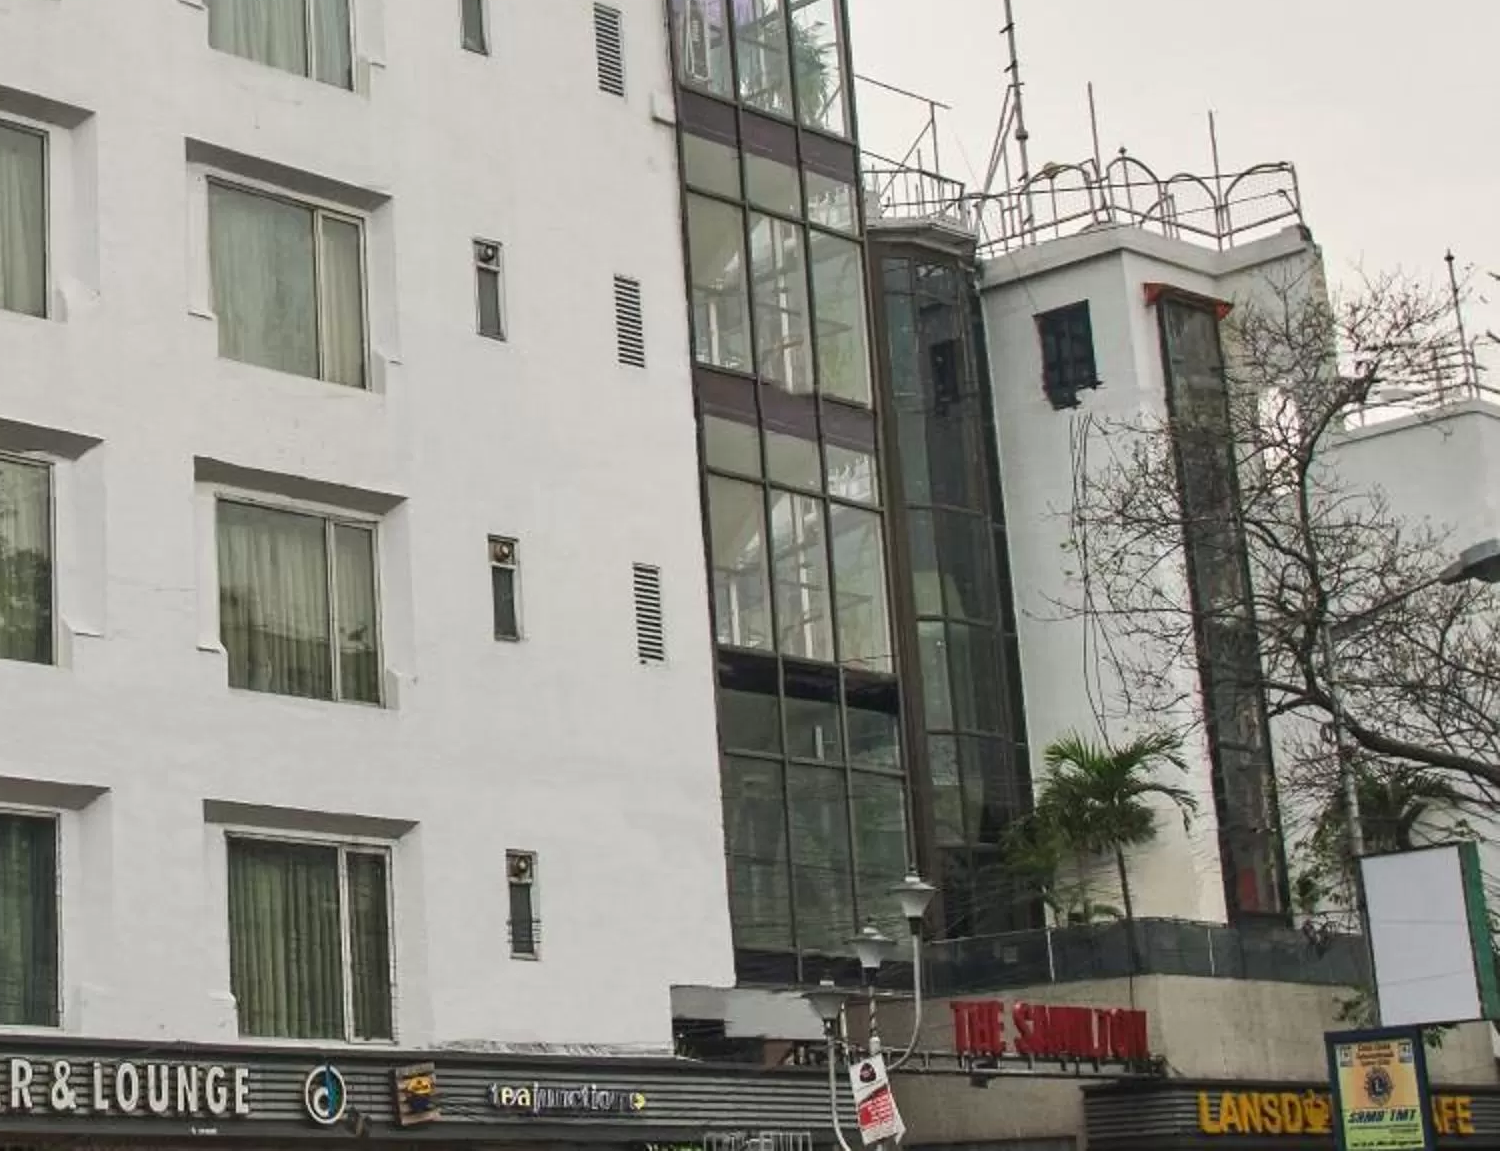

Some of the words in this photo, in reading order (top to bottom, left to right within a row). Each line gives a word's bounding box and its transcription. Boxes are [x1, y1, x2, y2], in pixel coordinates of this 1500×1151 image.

[950, 1001, 1006, 1056] THE
[51, 1060, 77, 1110] &
[93, 1061, 249, 1114] LOUNGE
